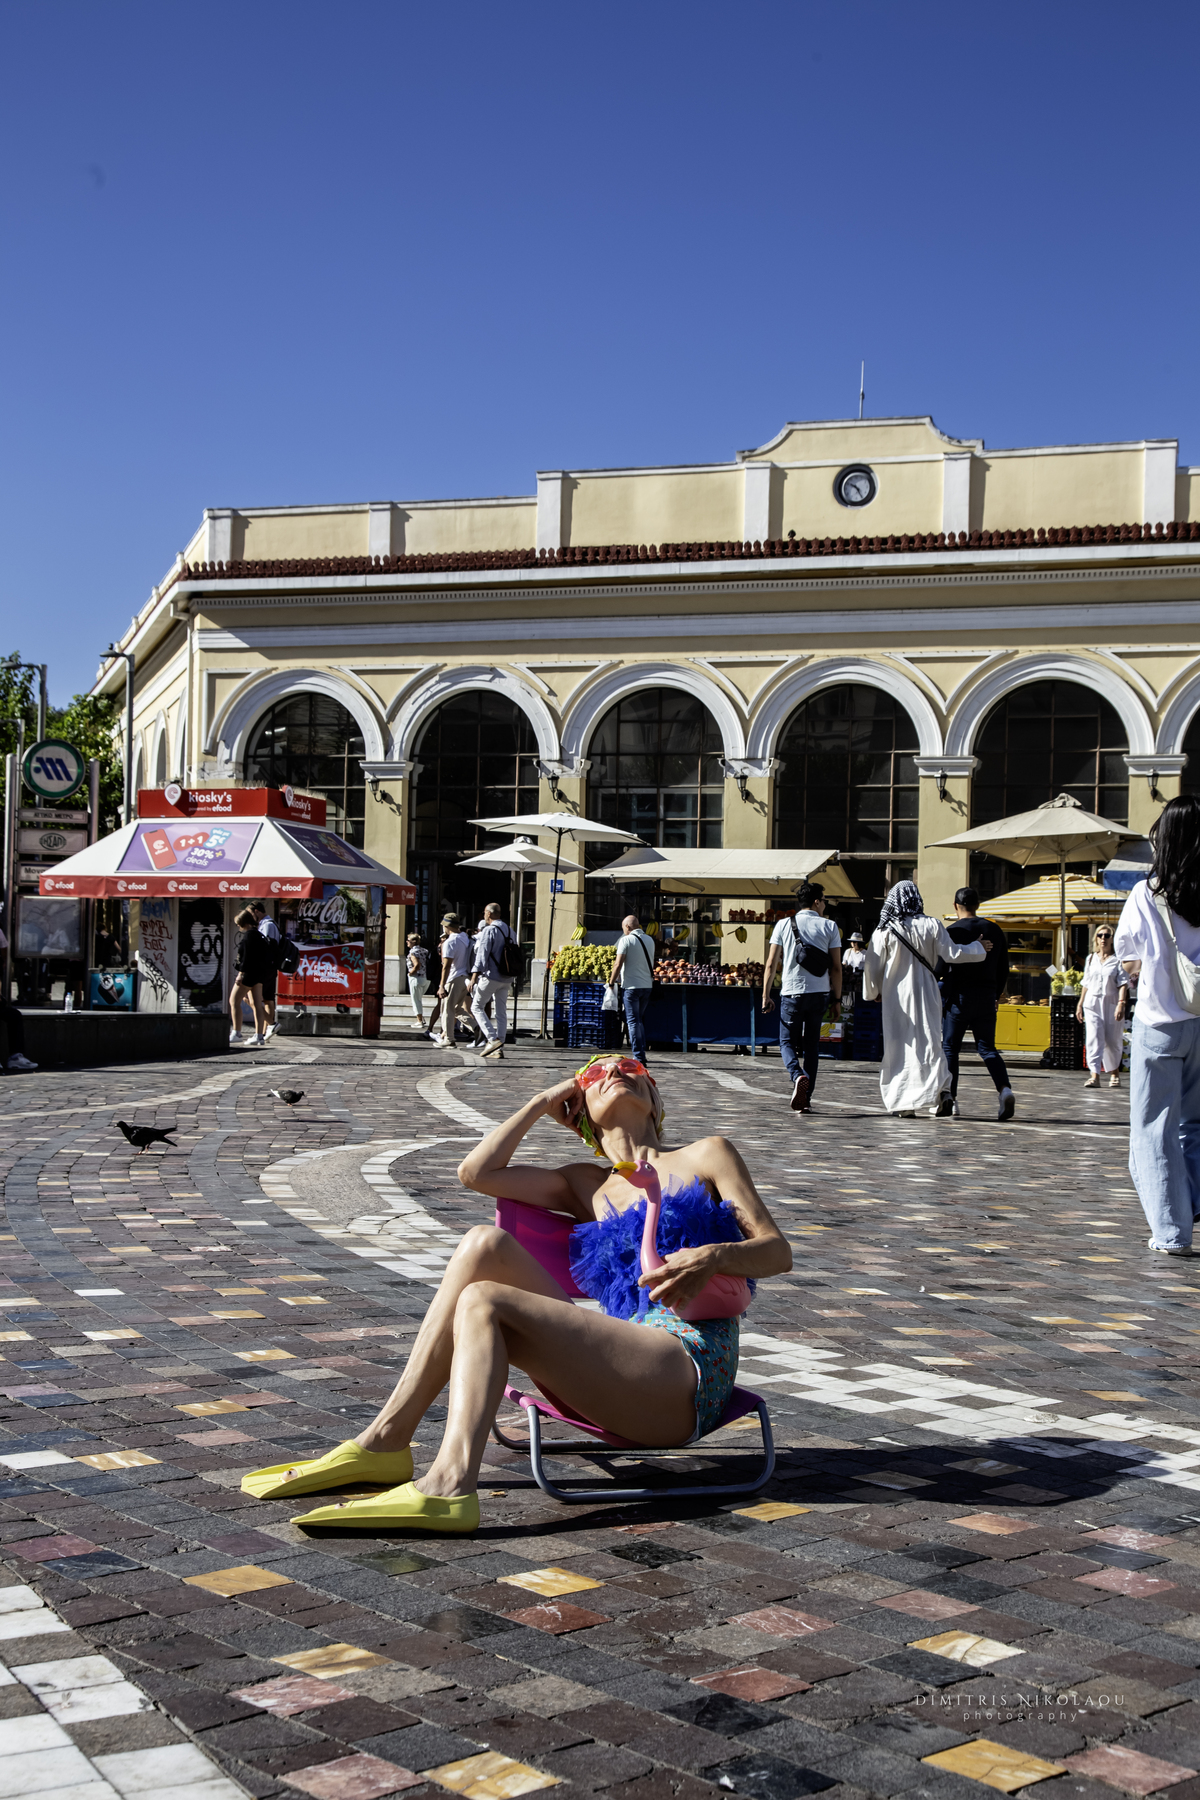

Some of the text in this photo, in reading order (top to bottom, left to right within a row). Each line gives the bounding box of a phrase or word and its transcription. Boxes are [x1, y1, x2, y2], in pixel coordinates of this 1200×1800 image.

[189, 791, 232, 804] kiosky's
[212, 804, 232, 812] efood
[55, 881, 75, 890] efood
[127, 882, 148, 890] efood
[178, 883, 198, 891] efood
[229, 883, 250, 891] efood
[281, 884, 302, 892] efood
